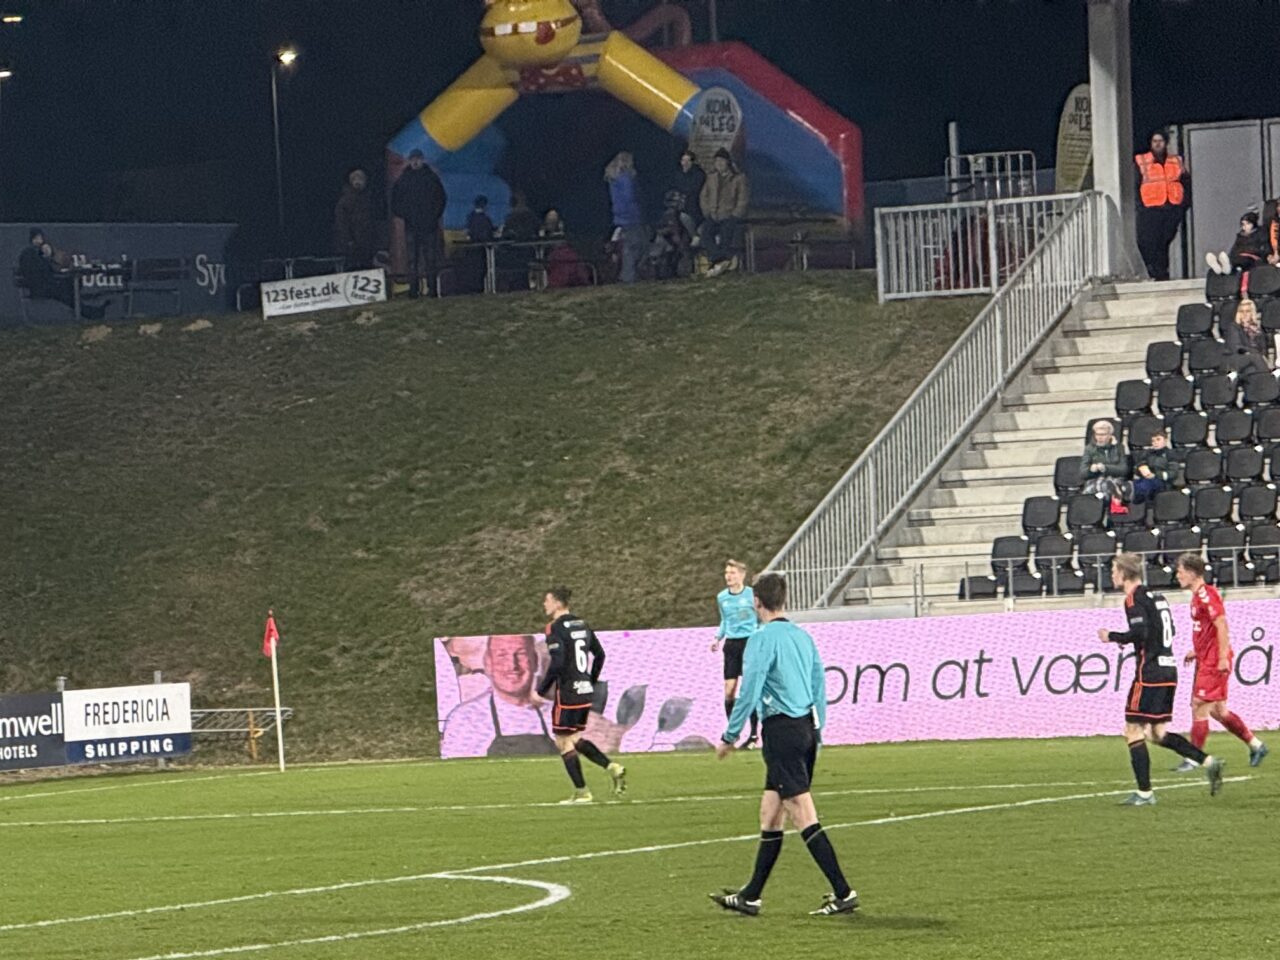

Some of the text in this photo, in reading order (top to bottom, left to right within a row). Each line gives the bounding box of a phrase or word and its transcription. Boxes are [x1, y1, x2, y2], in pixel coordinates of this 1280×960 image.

[264, 281, 341, 304] 123fest.dk
[351, 274, 382, 295] 123
[574, 639, 588, 673] 6
[931, 650, 993, 701] at
[84, 698, 171, 727] FREDERICIA
[84, 738, 174, 758] SHIPPING
